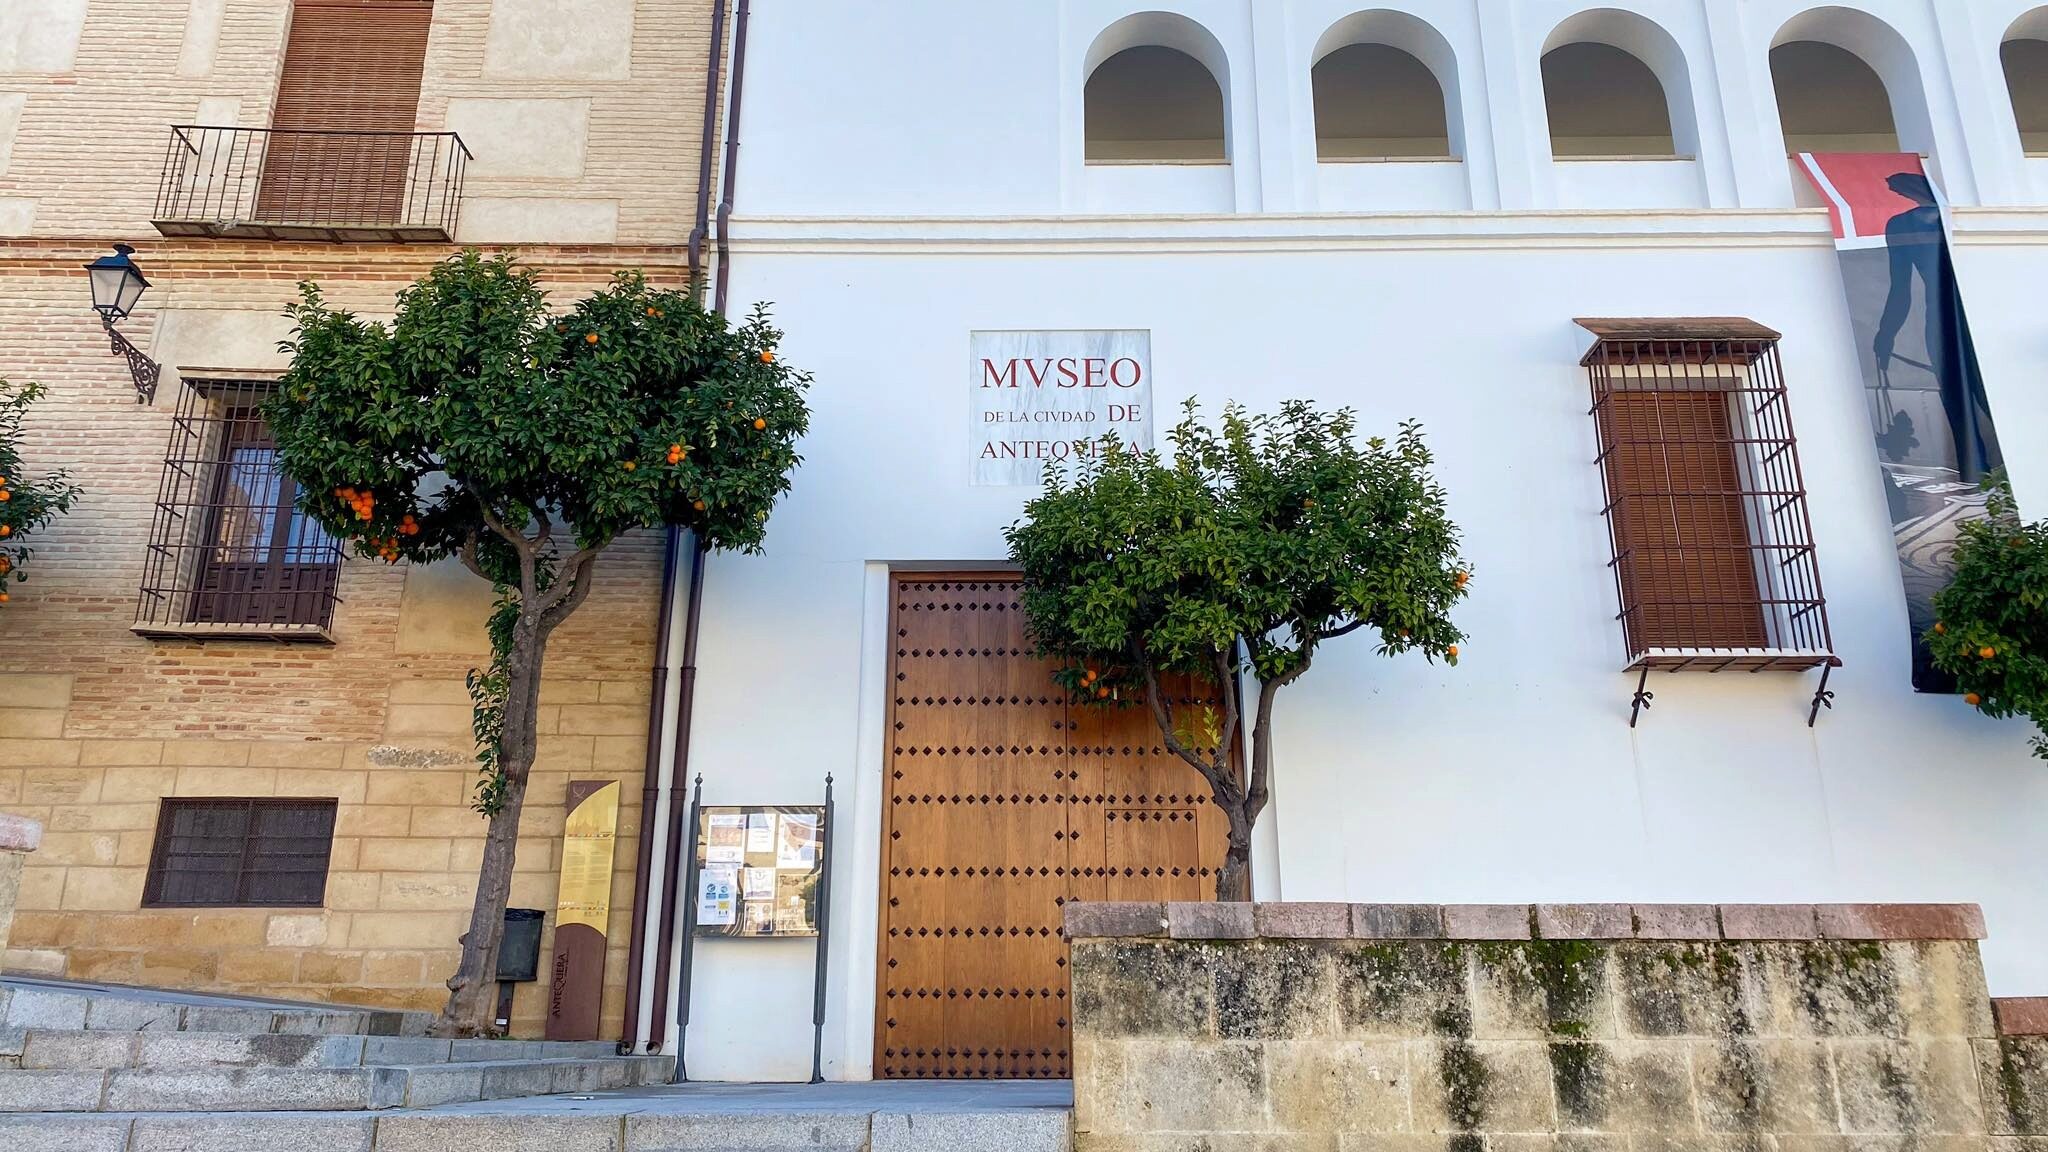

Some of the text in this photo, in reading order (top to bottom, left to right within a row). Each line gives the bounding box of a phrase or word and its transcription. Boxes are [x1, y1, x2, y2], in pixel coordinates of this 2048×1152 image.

[980, 357, 1142, 388] MVSEO
[984, 404, 1142, 423] DE LA CIVDAD DE
[980, 440, 1144, 462] ANTEQEA
[552, 952, 567, 1018] ANTEQUERA
